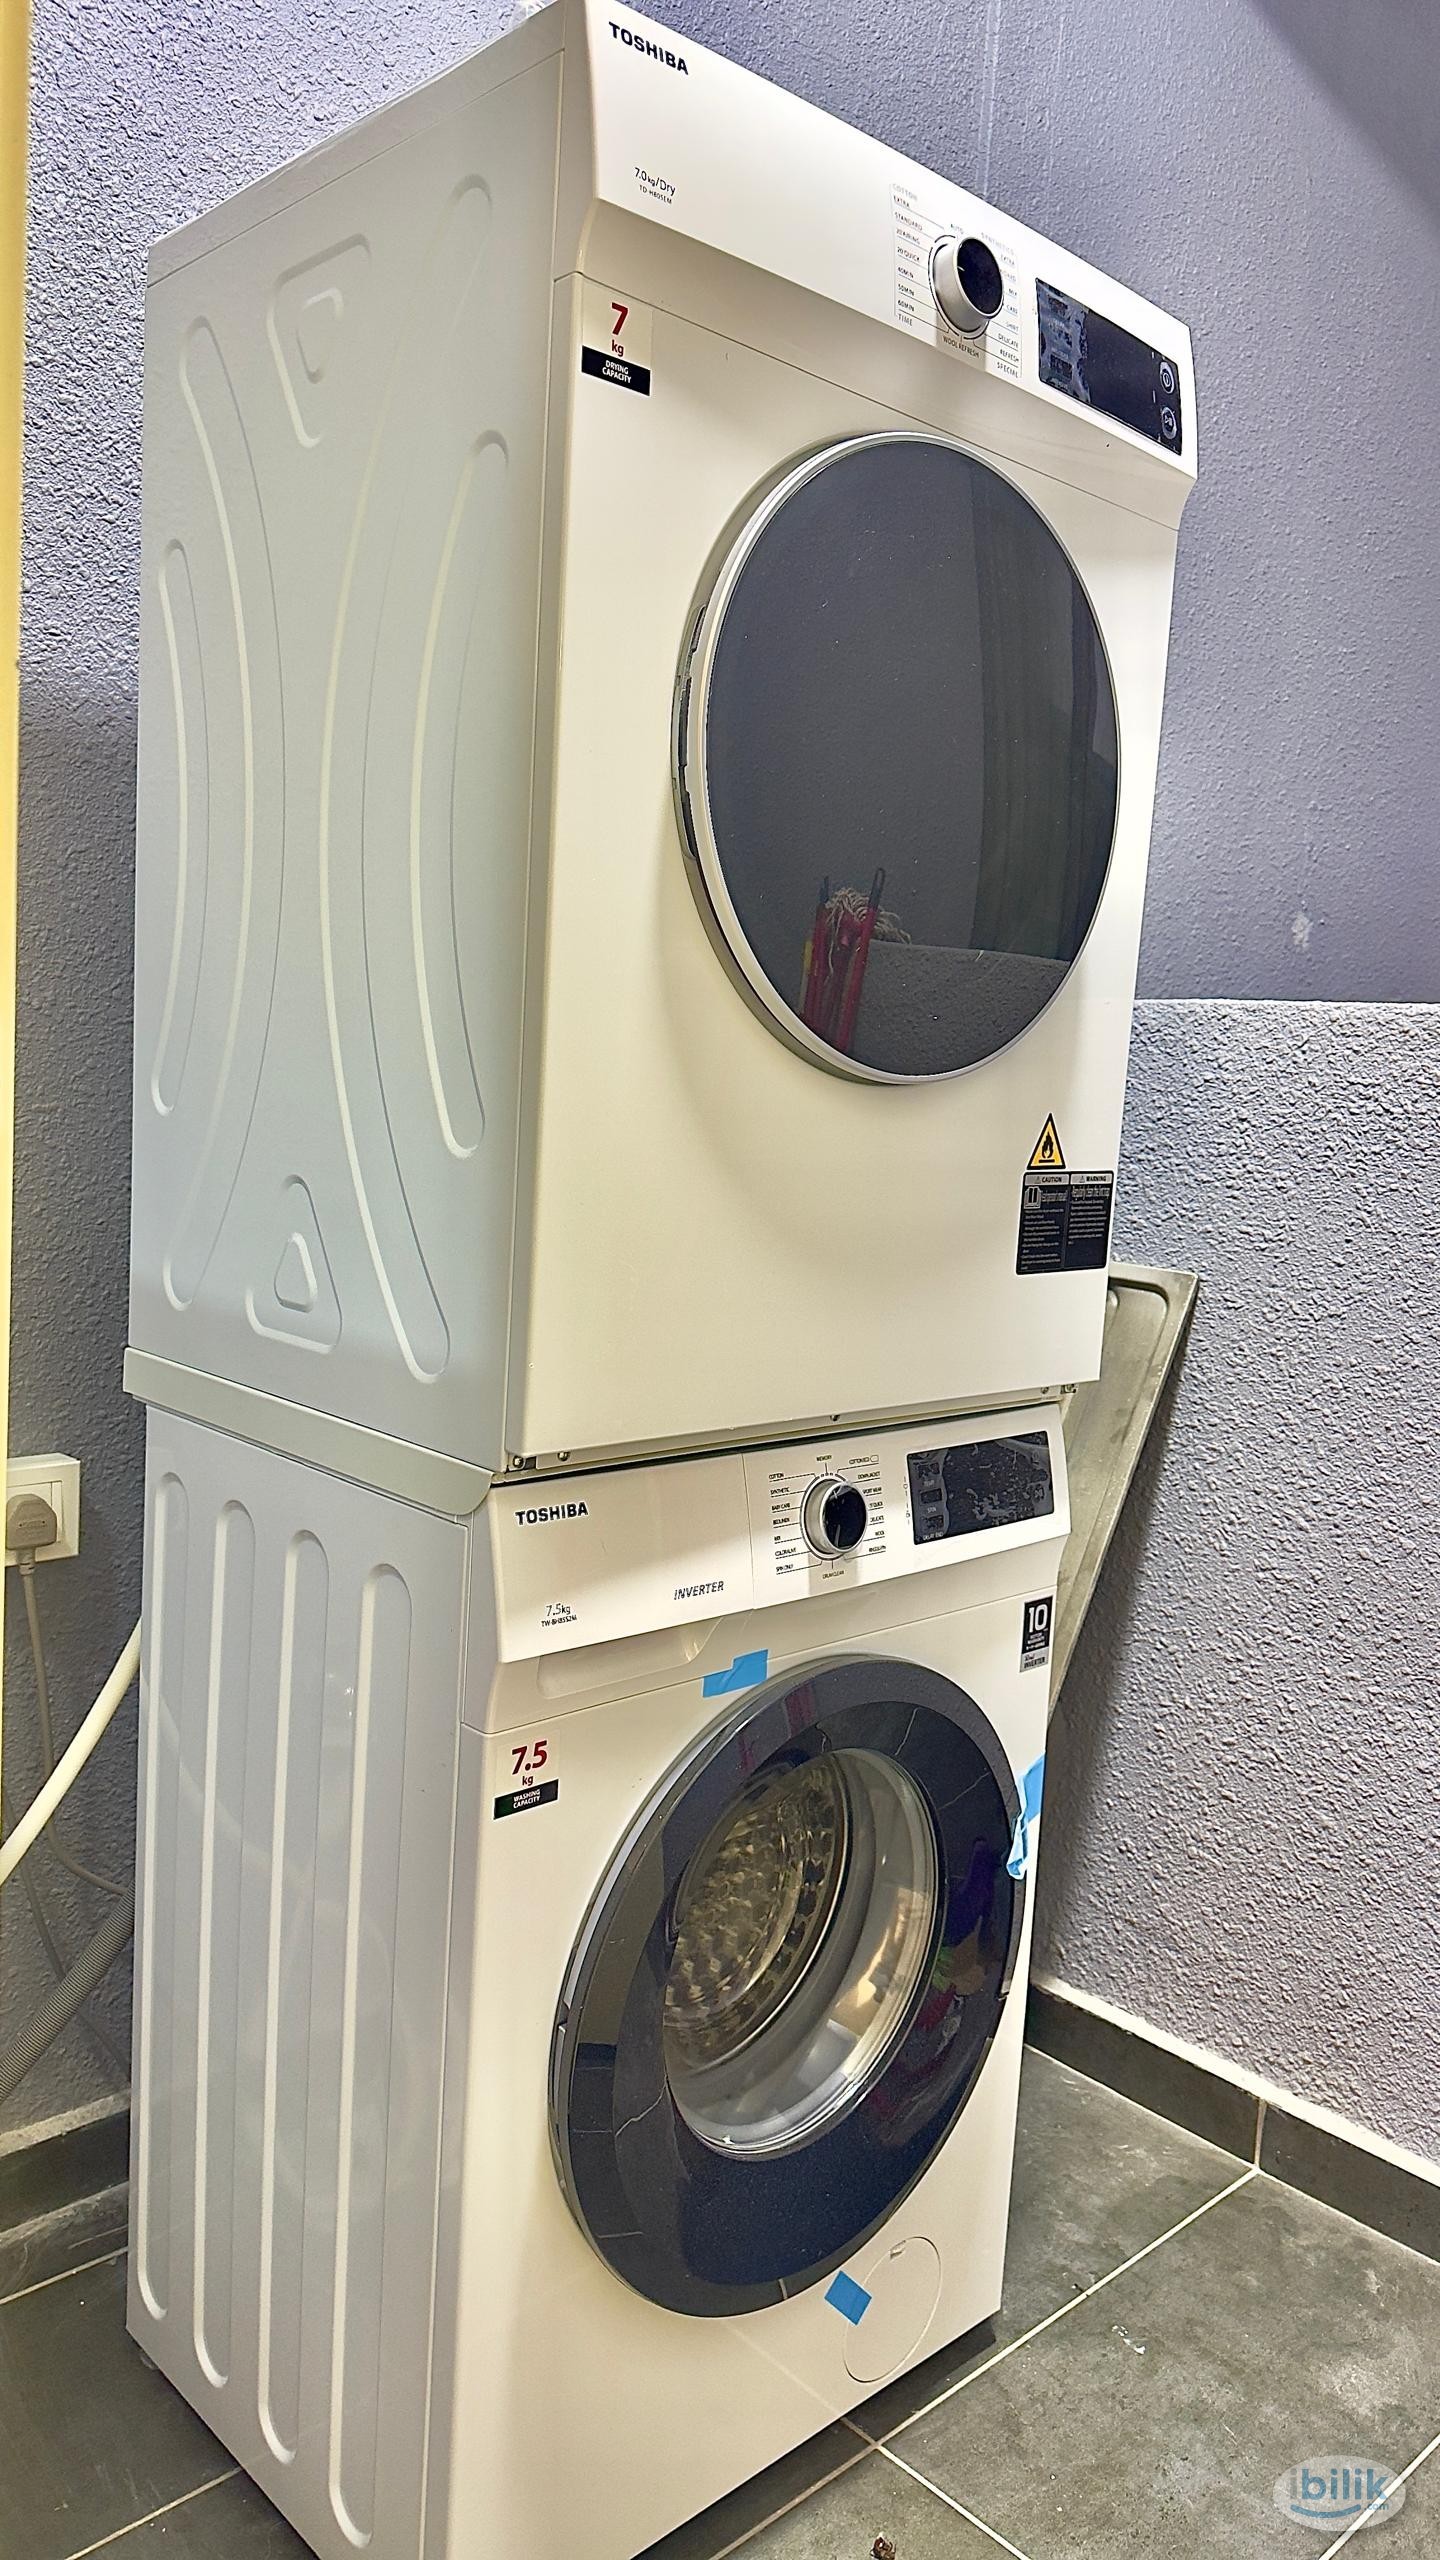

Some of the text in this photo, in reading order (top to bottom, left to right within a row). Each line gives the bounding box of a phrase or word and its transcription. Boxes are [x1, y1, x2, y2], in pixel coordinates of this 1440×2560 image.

[608, 21, 689, 75] TOSHIBA
[634, 166, 676, 197] 7.0kg/Dry
[611, 302, 628, 335] 7
[897, 313, 913, 326] TIME
[611, 339, 625, 357] kg
[942, 335, 958, 349] WOOL
[602, 367, 632, 383] CAPACITY
[605, 360, 629, 375] DRYING
[997, 361, 1019, 378] SPECIAL
[514, 1501, 589, 1526] TOSHIBA
[673, 1580, 725, 1600] INVERTER
[545, 1602, 571, 1617] 7.5kg
[1028, 1604, 1048, 1633] 10
[1024, 1656, 1046, 1669] INVERTER
[511, 1739, 548, 1775] 7.5
[521, 1775, 534, 1786] kg
[513, 1788, 541, 1802] WASHING
[513, 1795, 541, 1809] CAPACITY
